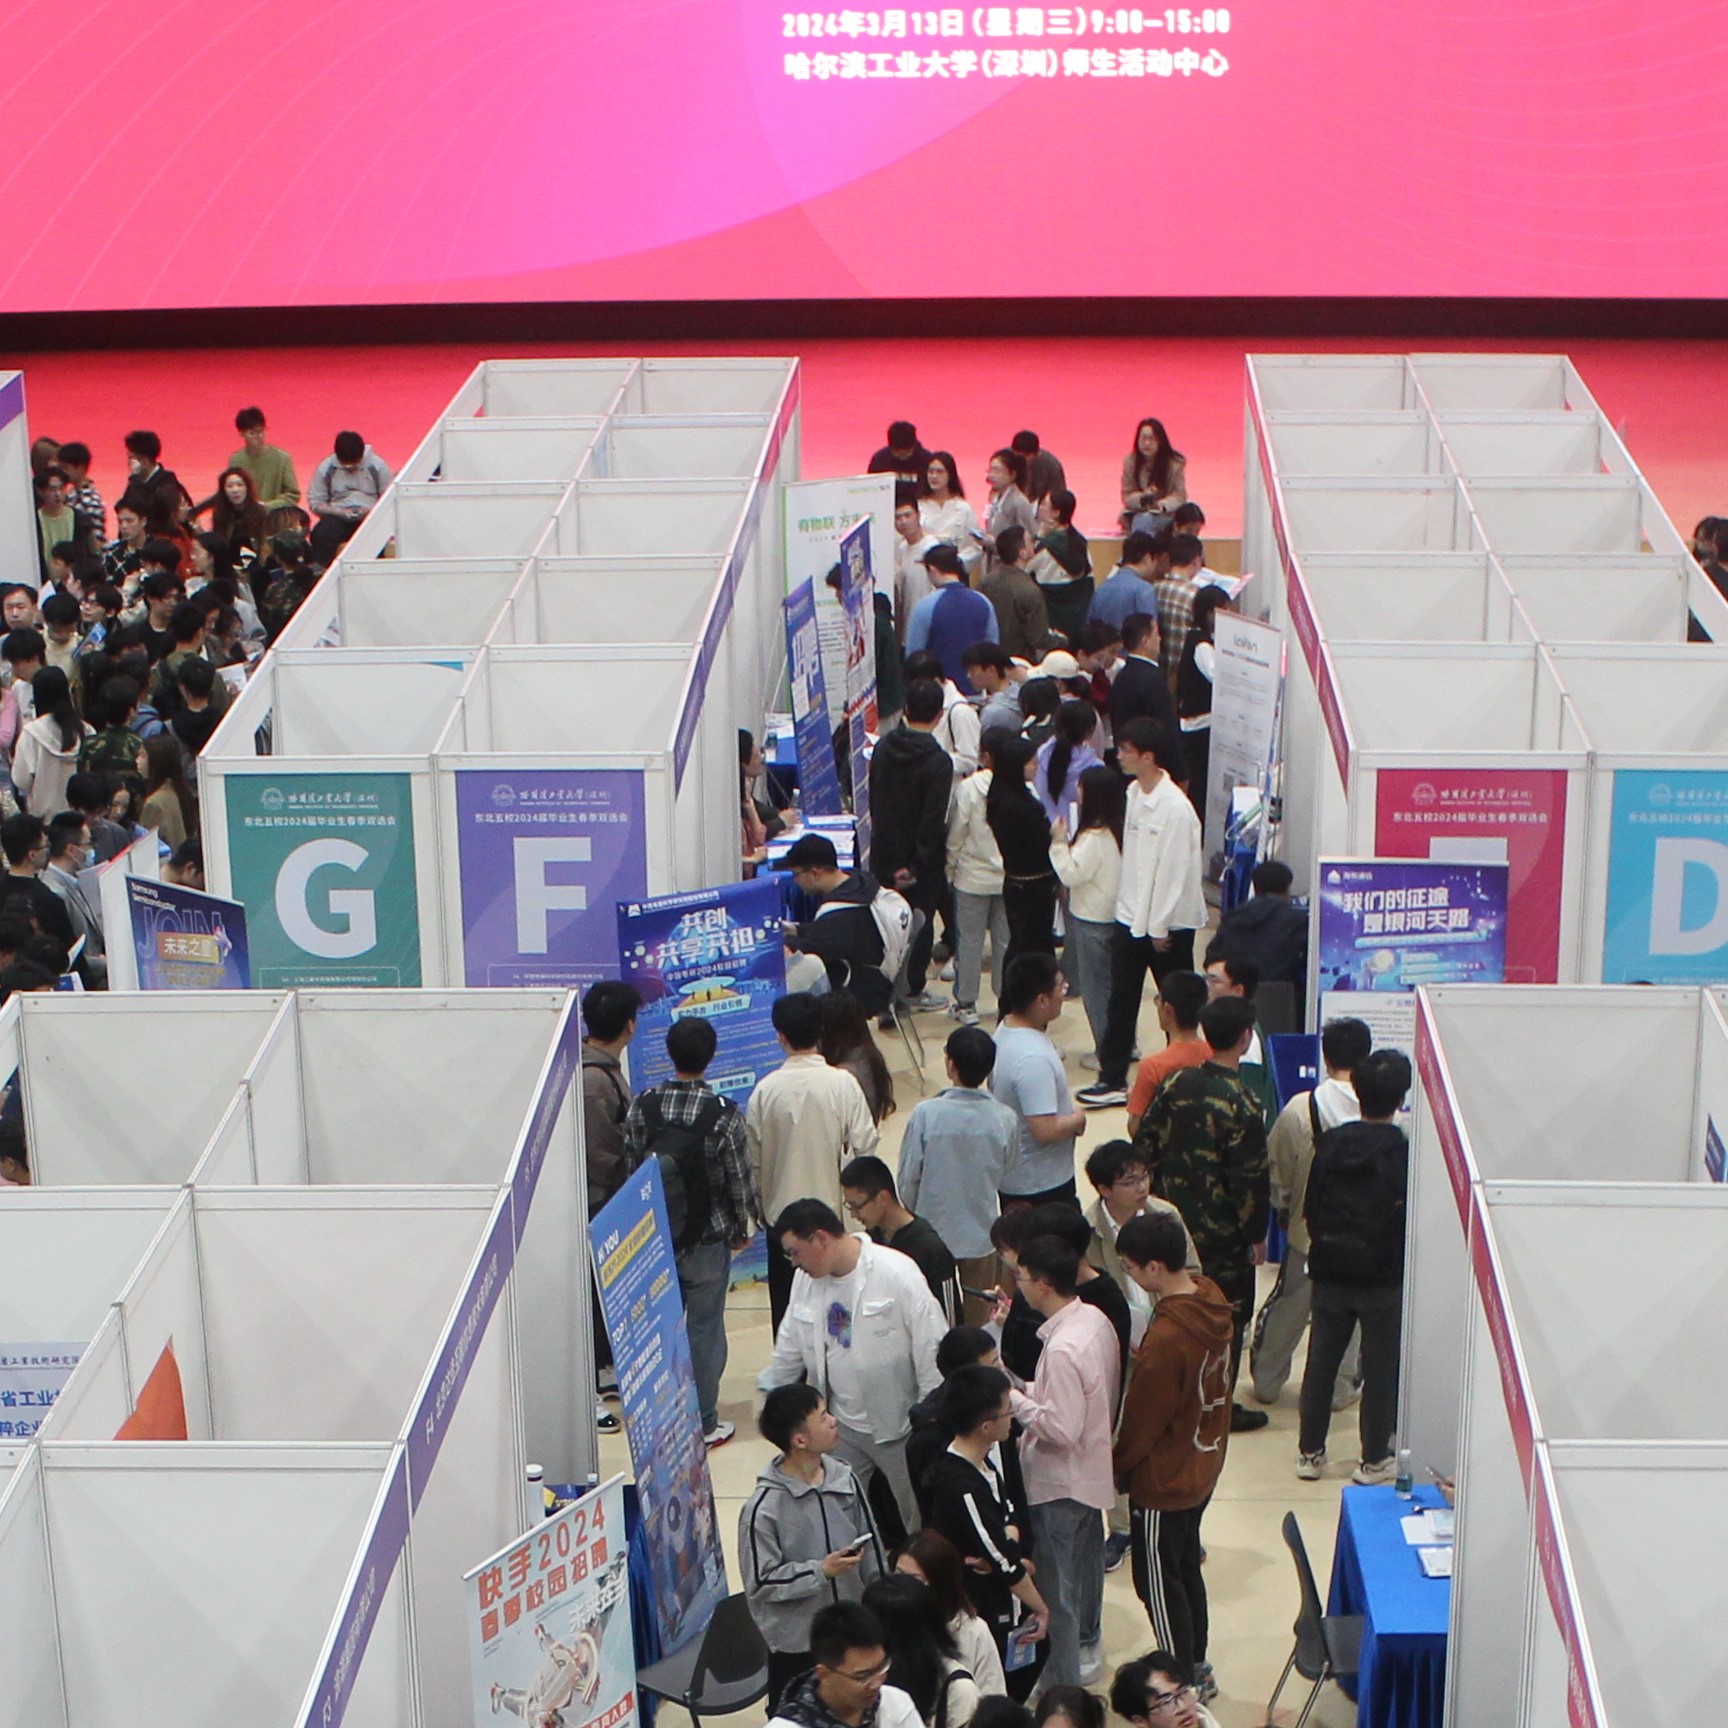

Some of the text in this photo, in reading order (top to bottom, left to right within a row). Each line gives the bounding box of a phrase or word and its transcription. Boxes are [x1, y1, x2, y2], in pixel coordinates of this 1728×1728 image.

[274, 837, 378, 959] G
[513, 836, 592, 954] F
[680, 907, 728, 936] 共创
[1342, 886, 1450, 913] 我们的征途
[656, 928, 757, 969] 共享共担
[481, 1535, 609, 1643] 春季校园招聘
